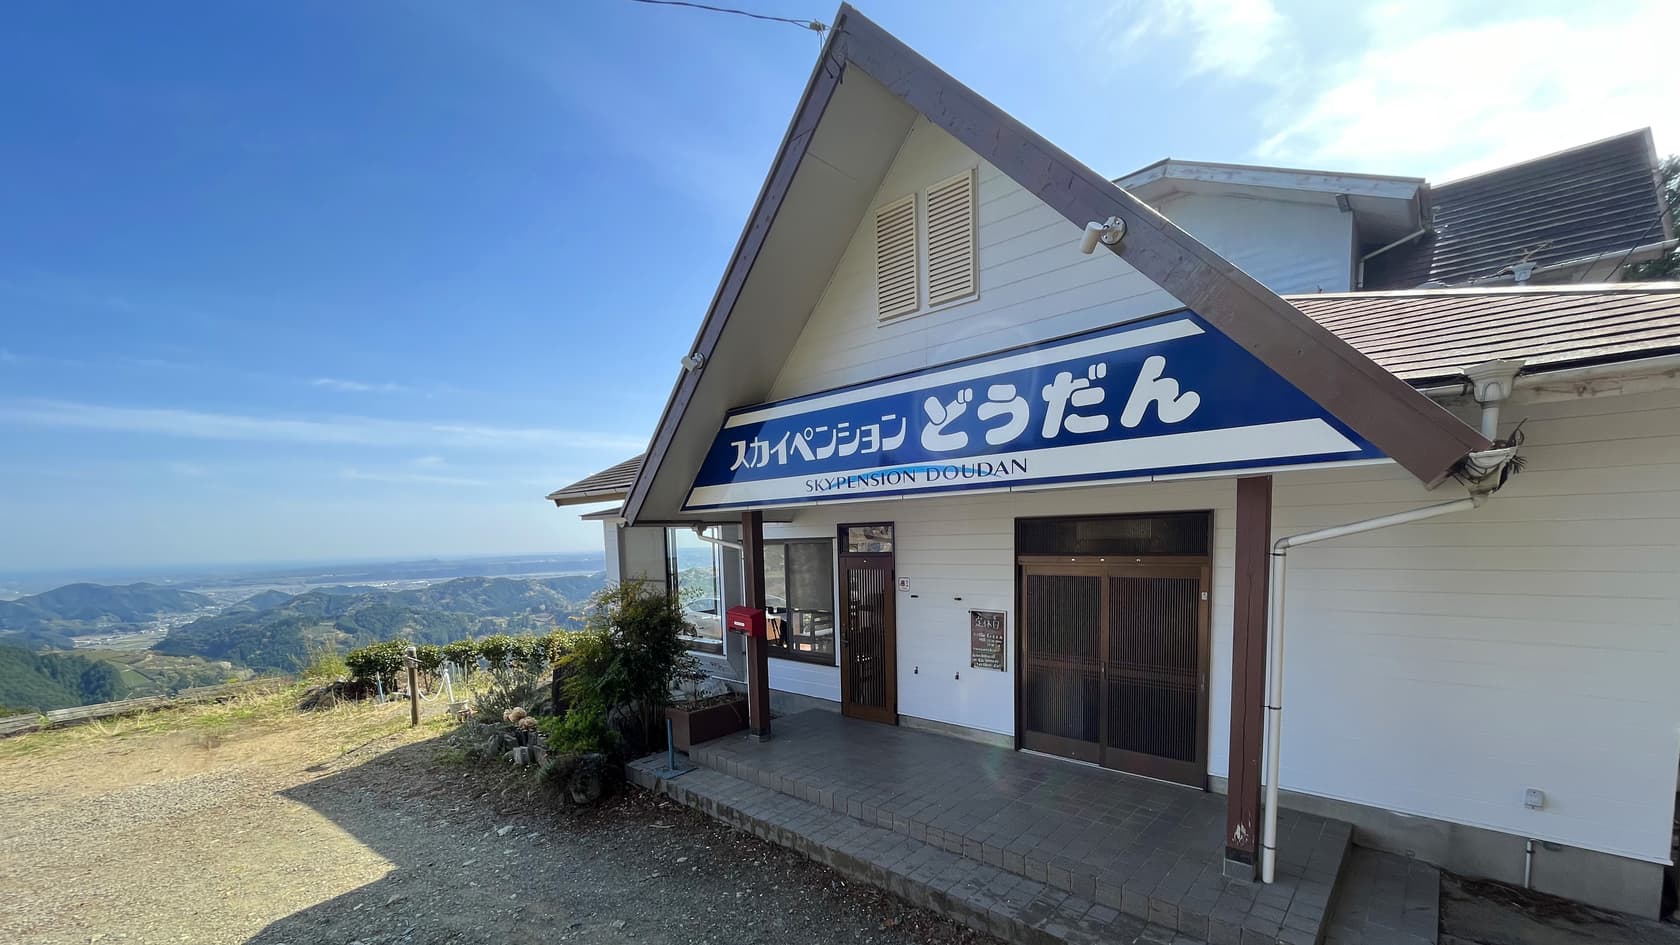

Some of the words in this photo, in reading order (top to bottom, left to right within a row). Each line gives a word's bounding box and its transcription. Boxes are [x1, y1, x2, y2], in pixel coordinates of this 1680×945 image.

[730, 414, 906, 471] スカイペンション
[921, 356, 1200, 452] どうだん
[805, 468, 915, 493] SKYPENSION
[926, 458, 1027, 482] DOUDAN
